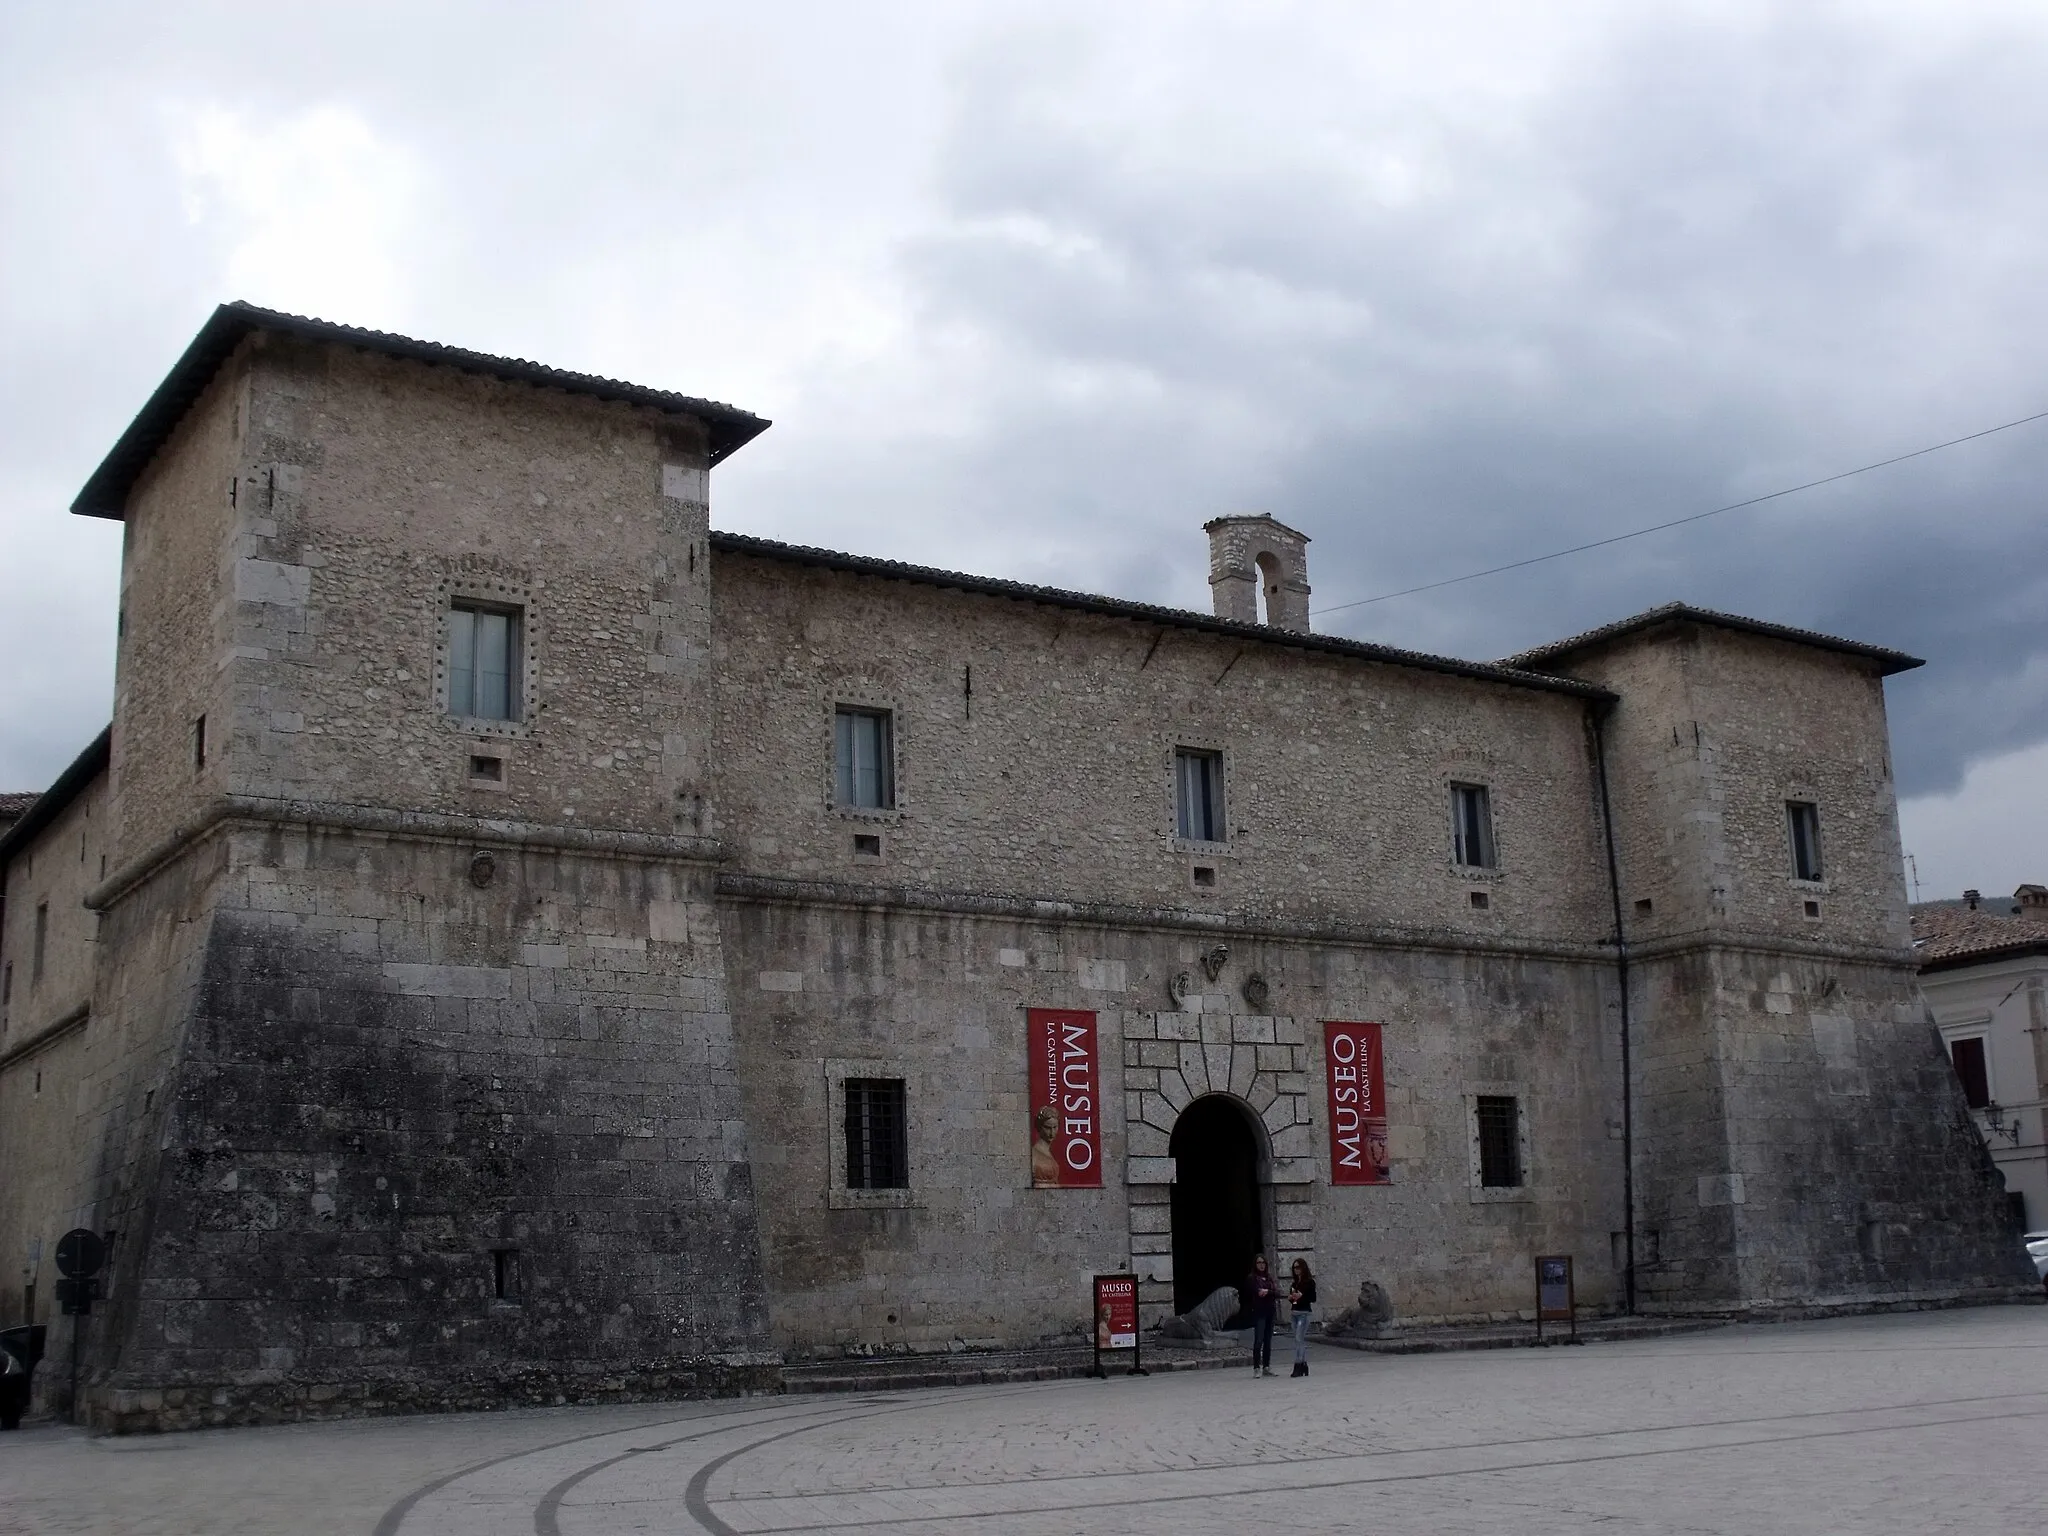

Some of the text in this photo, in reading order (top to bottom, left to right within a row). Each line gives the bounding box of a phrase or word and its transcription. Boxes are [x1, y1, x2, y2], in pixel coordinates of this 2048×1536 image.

[1047, 1022, 1058, 1104] LA CASTELLINA
[1062, 1022, 1093, 1170] MUSEO
[1333, 1033, 1362, 1170] MUSEO
[1360, 1037, 1371, 1112] LA CASTELLINA
[1102, 1283, 1132, 1293] MUSEO
